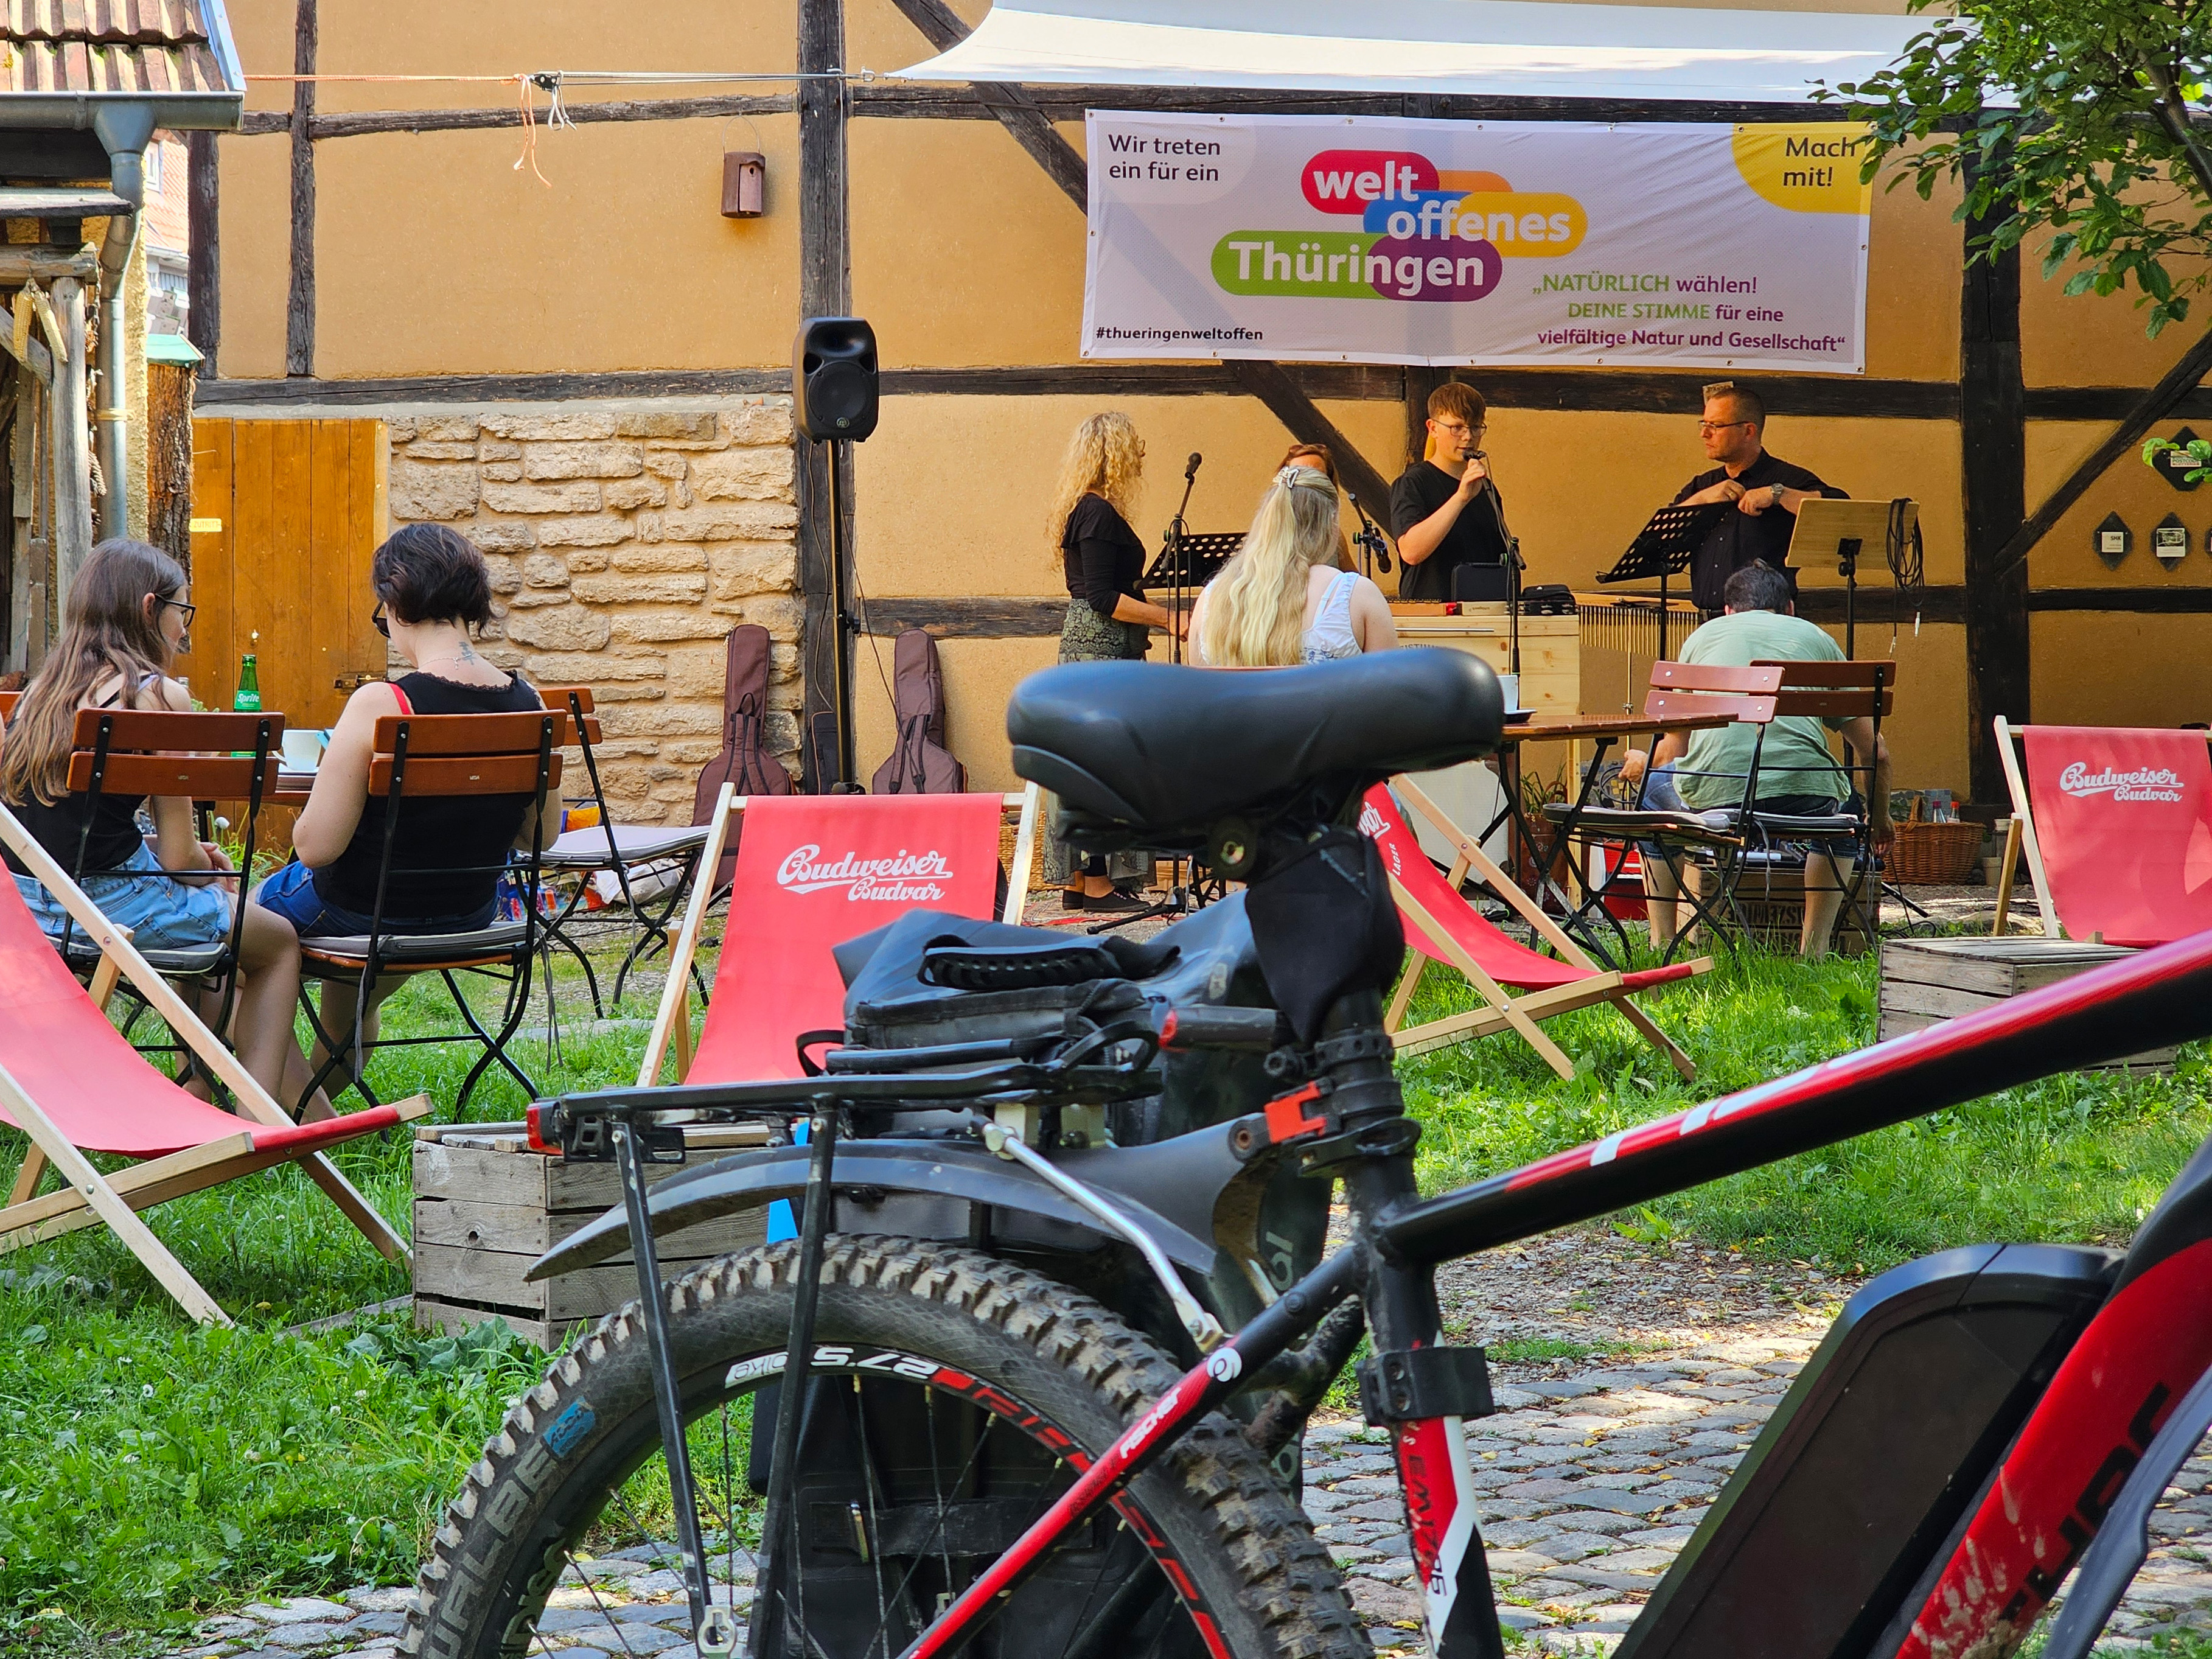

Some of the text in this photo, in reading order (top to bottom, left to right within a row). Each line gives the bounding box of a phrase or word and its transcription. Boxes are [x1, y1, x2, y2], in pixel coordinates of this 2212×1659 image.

[1108, 134, 1221, 155] Wir treten
[1785, 136, 1855, 157] Mach
[1109, 161, 1218, 181] ein für ein
[1312, 160, 1420, 202] welt
[1783, 166, 1833, 187] mit!
[1386, 200, 1572, 243] offenes
[1228, 240, 1484, 297] Thüringen
[1676, 275, 1757, 294] wählen!
[1568, 302, 1784, 322] DEINE STIMME für eine
[1095, 326, 1263, 342] #thueringenweltoffen
[1537, 328, 1627, 349] vielfältige
[1631, 329, 1684, 346] Natur
[1689, 330, 1723, 347] und
[237, 693, 259, 704] Sprite
[2059, 761, 2185, 791] Budweiser
[2113, 783, 2183, 802] Budvar
[776, 844, 954, 885] Budweiser
[1389, 843, 1401, 876] LAGER
[848, 875, 946, 901] Budvar
